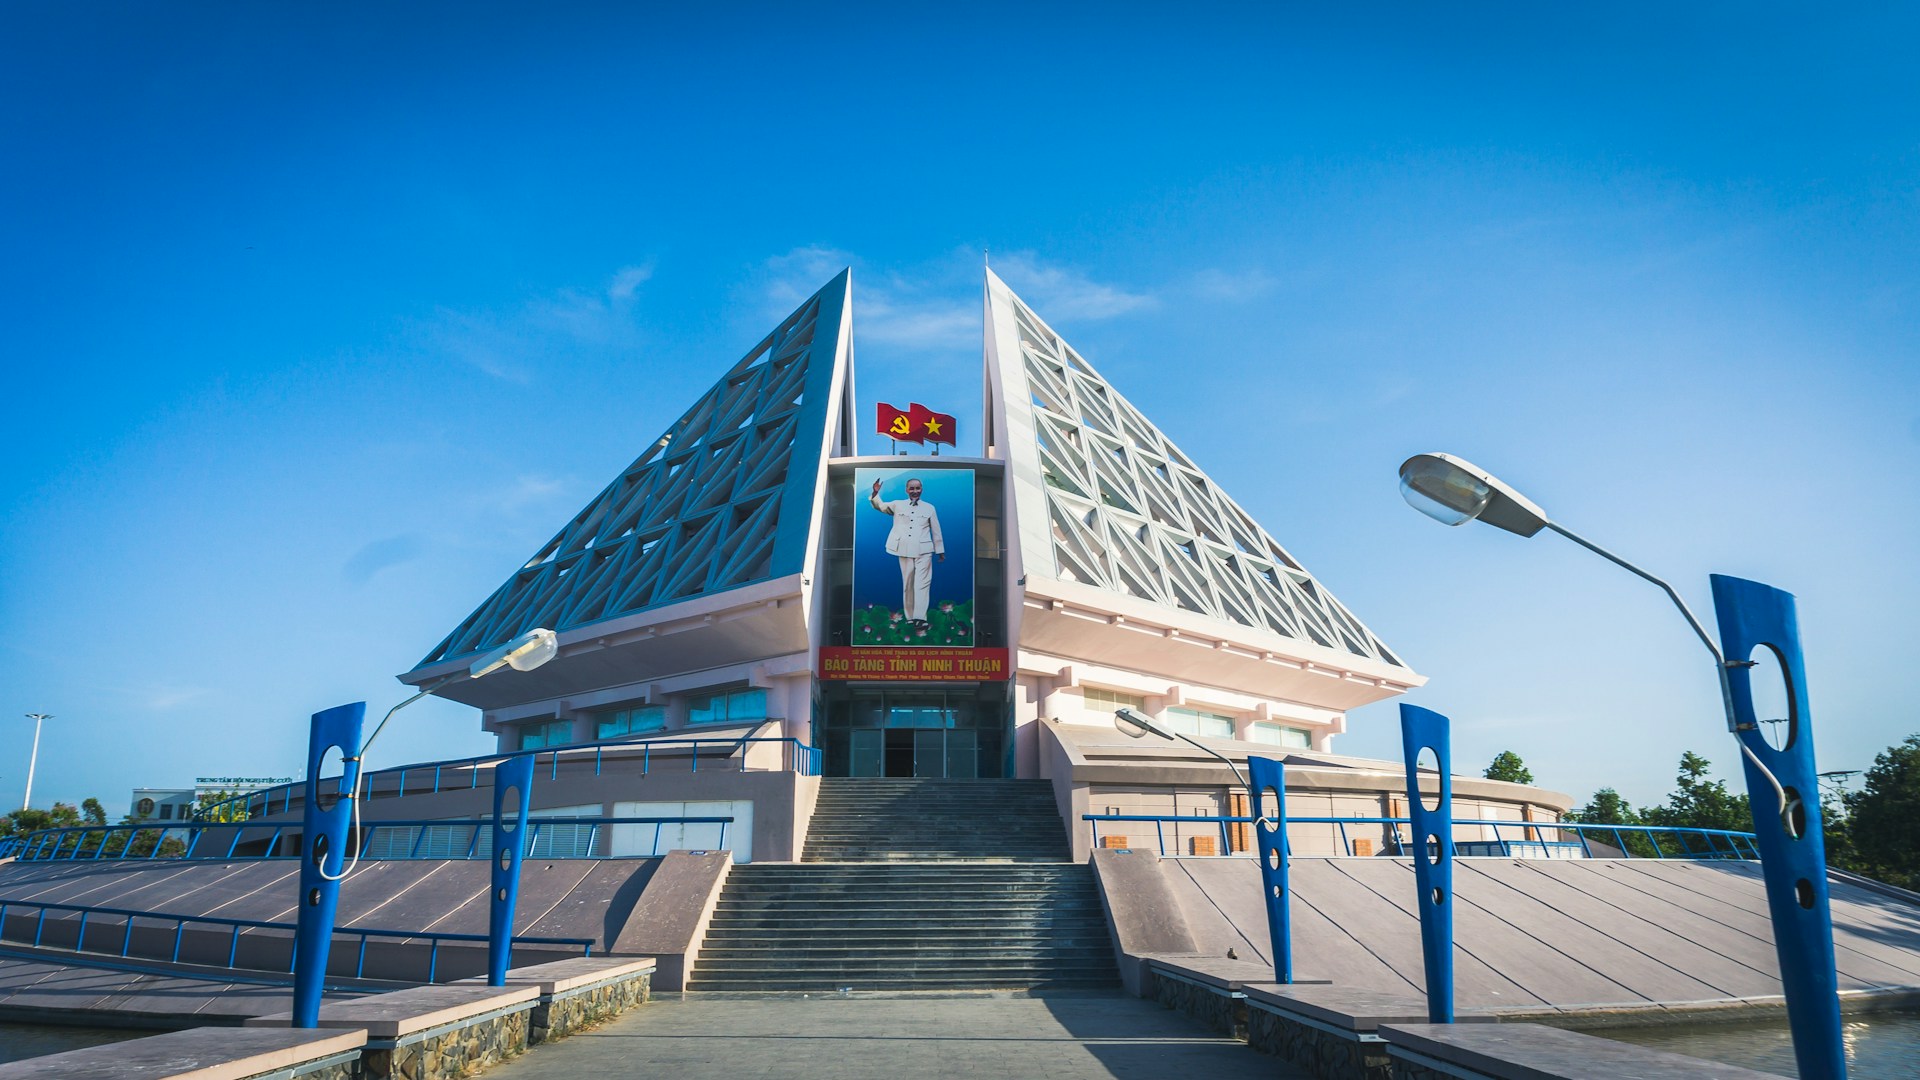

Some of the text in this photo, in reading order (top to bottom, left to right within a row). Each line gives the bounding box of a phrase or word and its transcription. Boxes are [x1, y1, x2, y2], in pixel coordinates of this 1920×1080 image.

[824, 655, 1001, 674] BẢO TÀNG TỈNH NINH THUẬN
